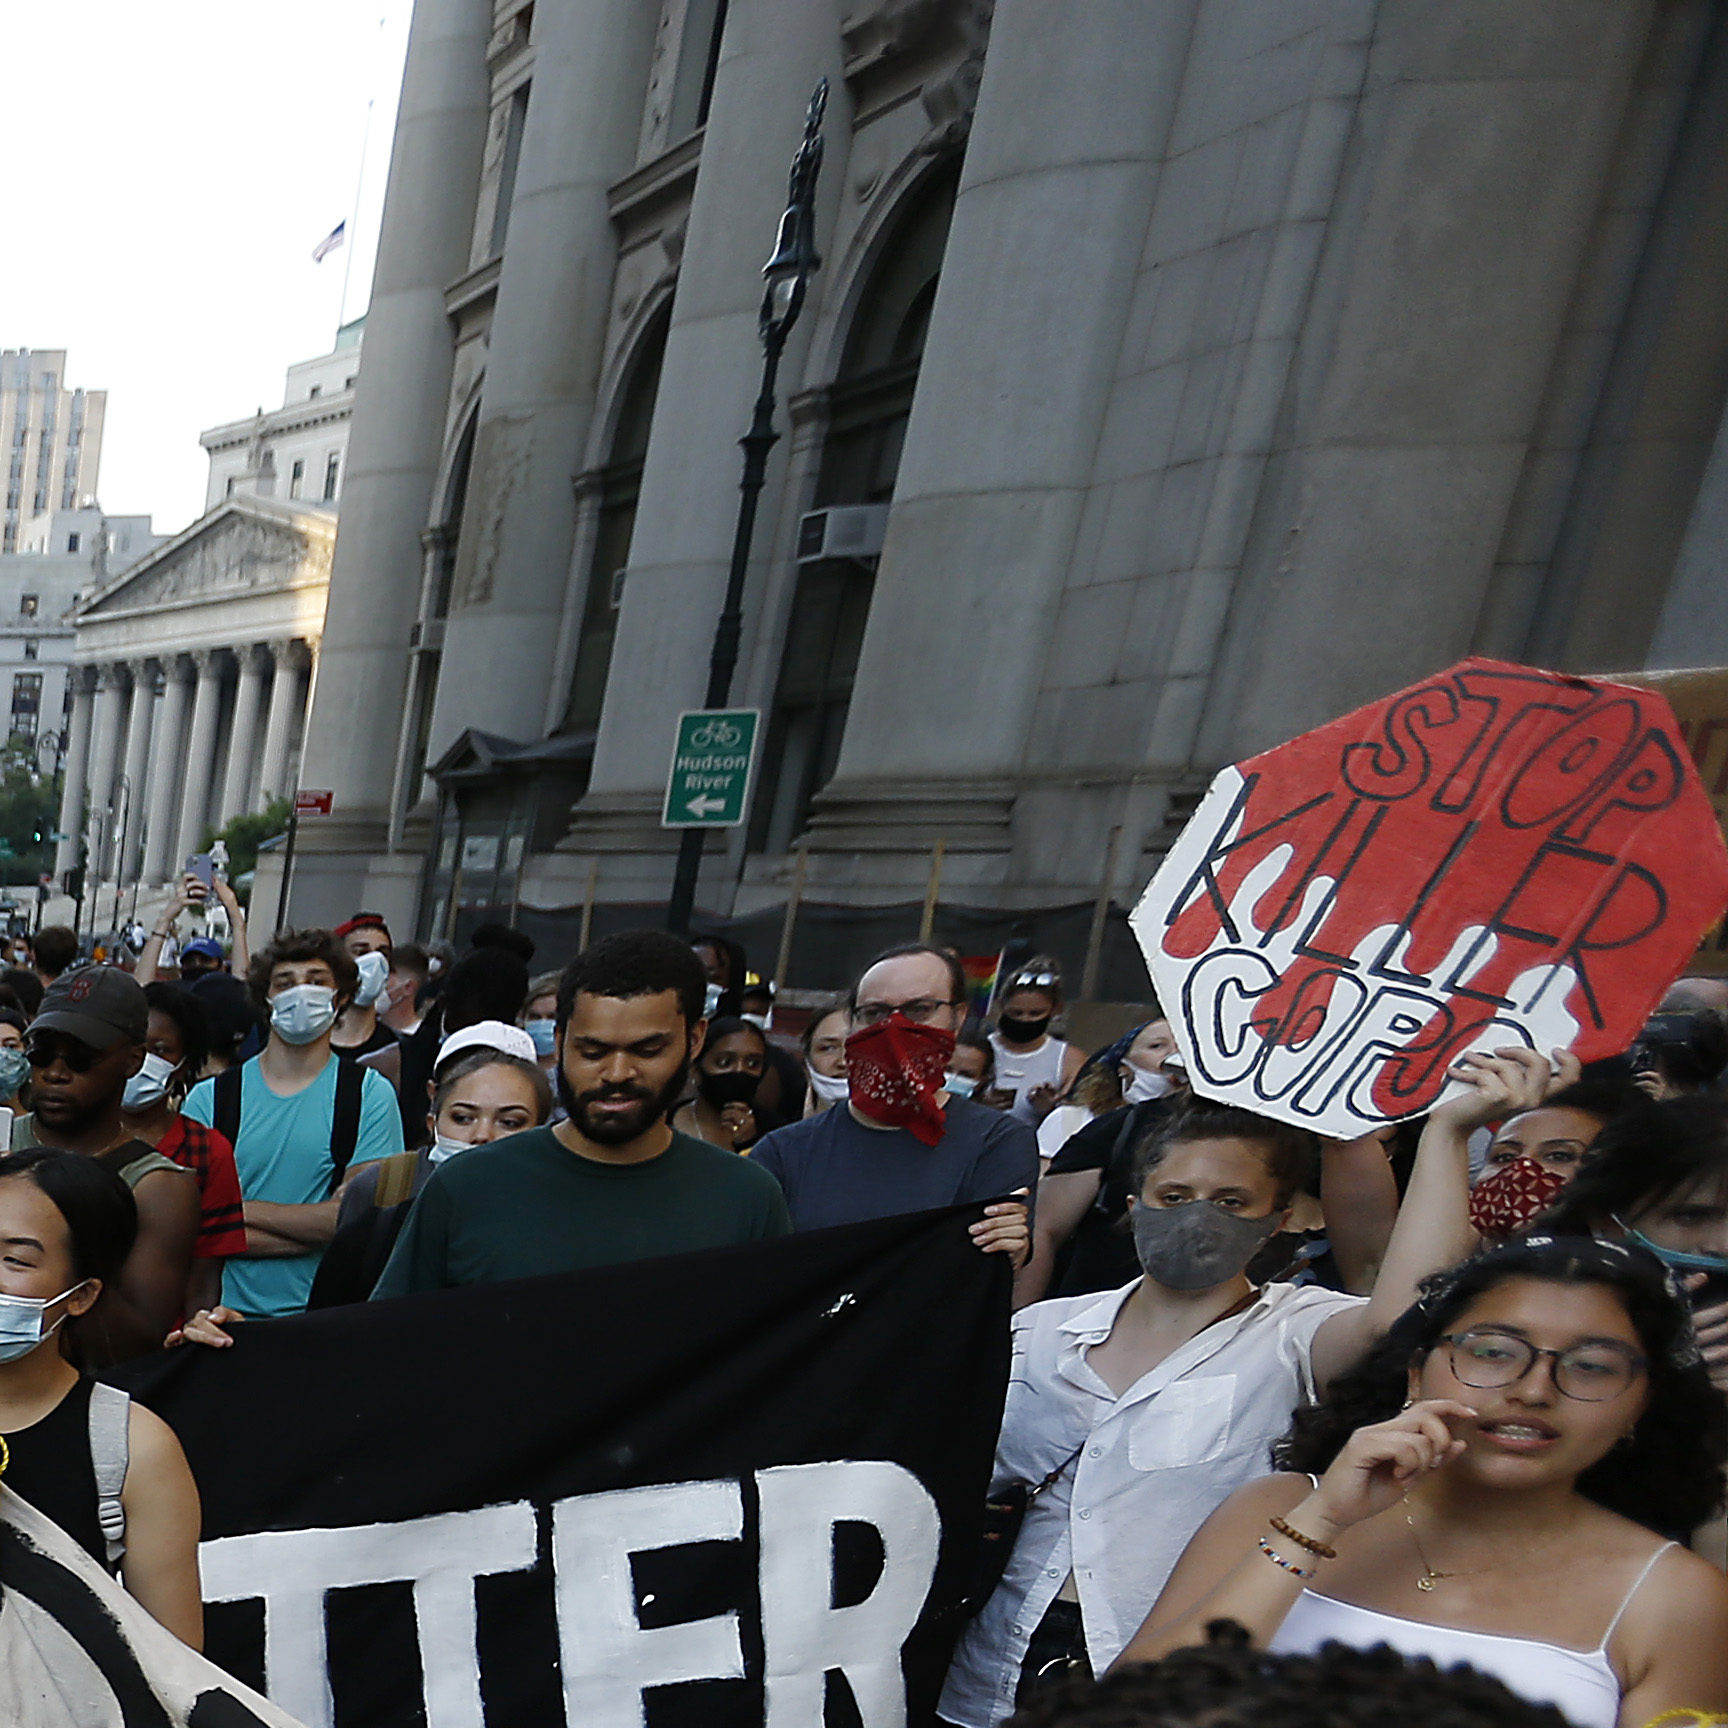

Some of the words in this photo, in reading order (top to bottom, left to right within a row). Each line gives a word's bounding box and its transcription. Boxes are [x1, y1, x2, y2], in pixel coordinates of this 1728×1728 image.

[677, 755, 747, 771] Hudson
[685, 773, 732, 789] River
[1343, 669, 1685, 844] STOP
[1164, 772, 1668, 1030] KILLER
[1182, 948, 1536, 1122] COPS
